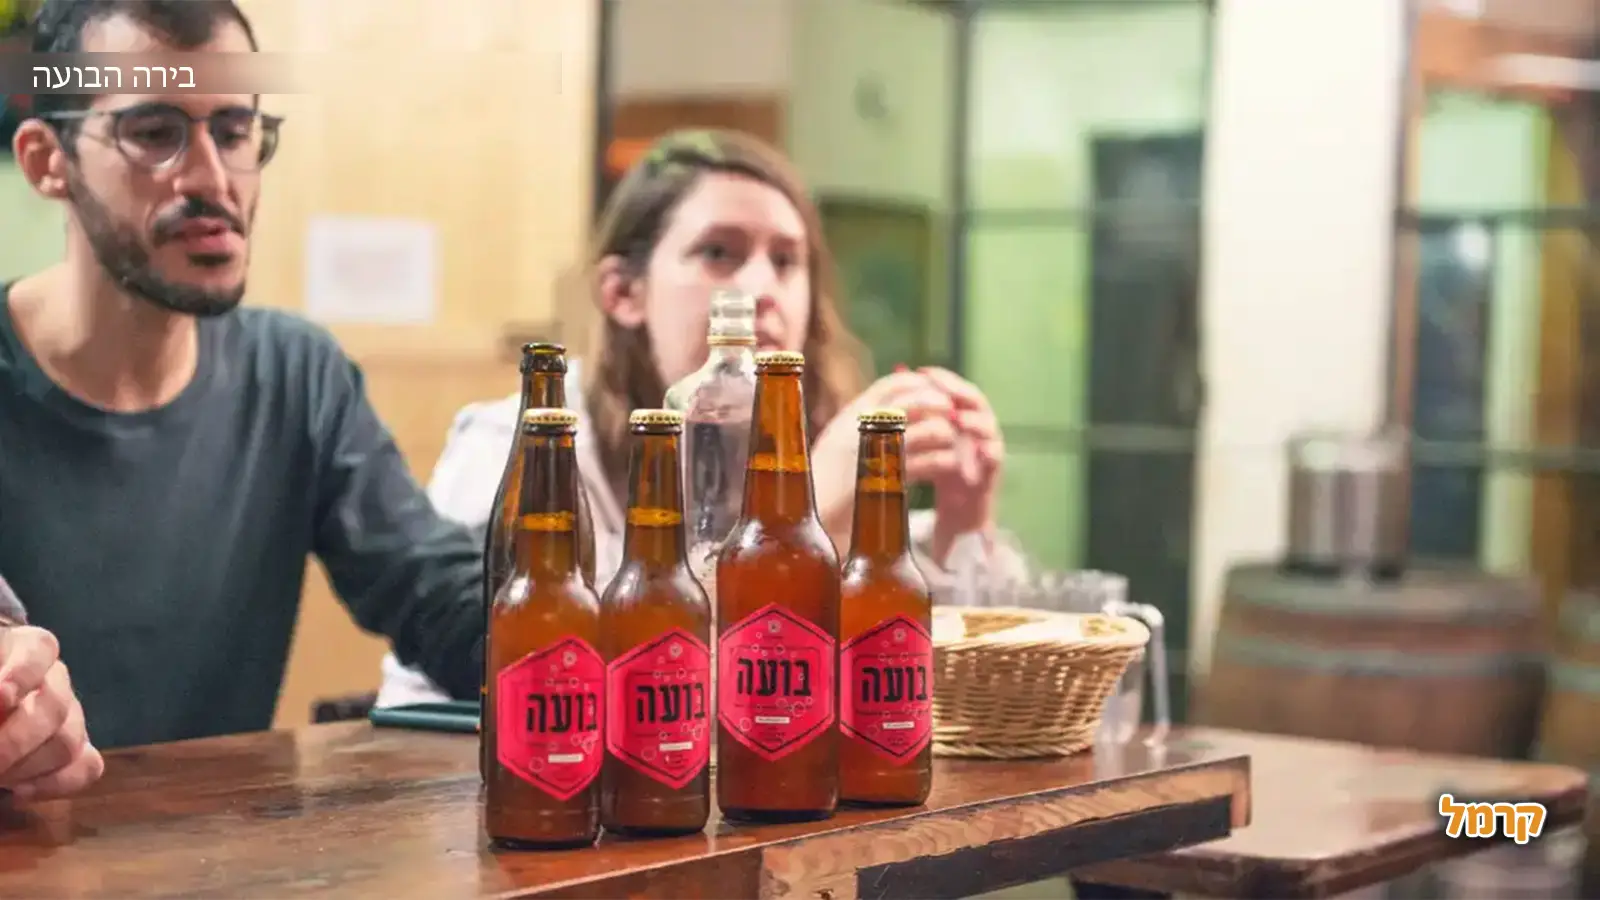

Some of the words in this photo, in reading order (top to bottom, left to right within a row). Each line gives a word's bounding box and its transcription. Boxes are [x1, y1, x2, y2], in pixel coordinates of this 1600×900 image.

[736, 657, 812, 697] בועה
[861, 665, 928, 704] בועה
[526, 692, 597, 733] בועה
[635, 682, 705, 724] בועה
